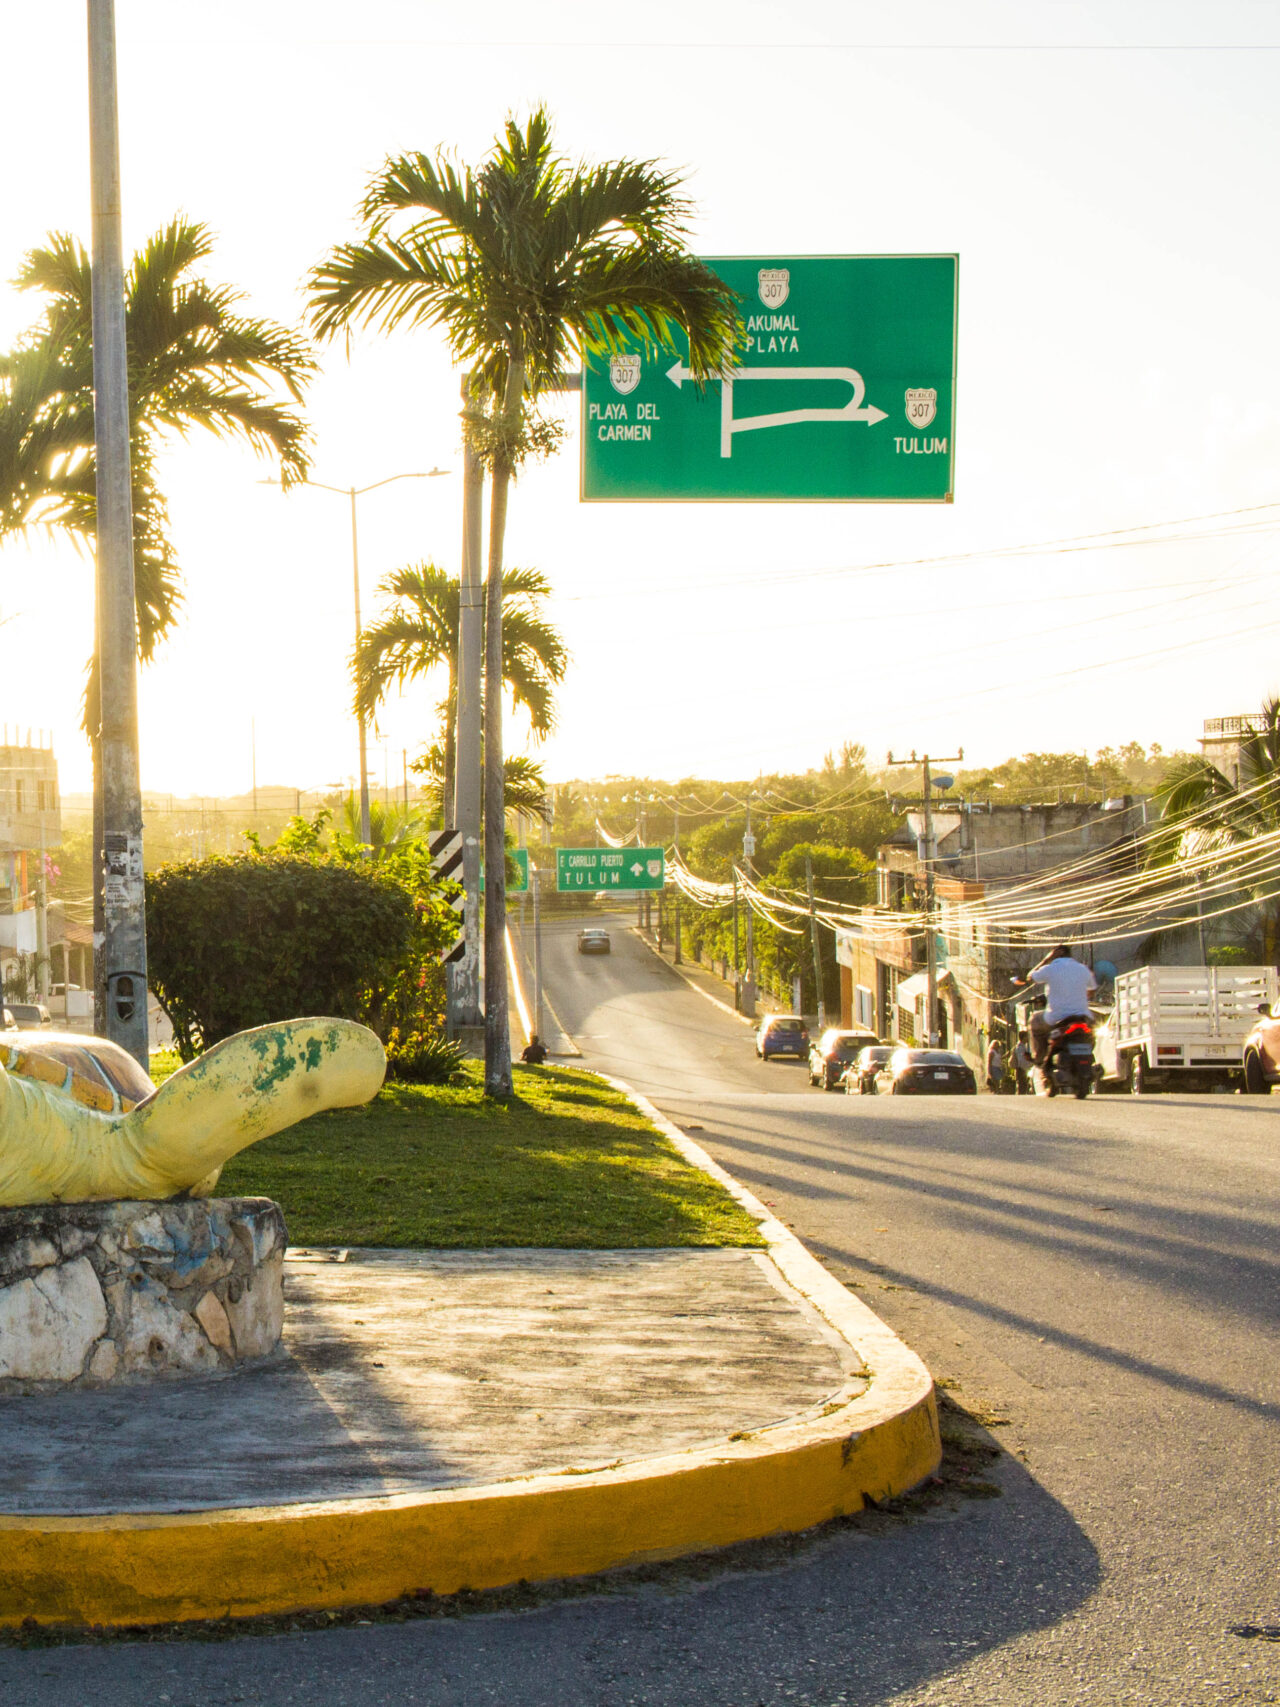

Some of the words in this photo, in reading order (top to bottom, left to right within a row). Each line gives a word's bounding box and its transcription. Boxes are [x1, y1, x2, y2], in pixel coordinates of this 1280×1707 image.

[765, 284, 782, 298] 307
[746, 315, 800, 332] AKUMAL
[745, 335, 799, 353] PLAYA
[616, 369, 634, 383] 307
[589, 403, 628, 420] PLAYA
[637, 403, 660, 420] DEL
[912, 403, 930, 418] 307
[598, 424, 652, 442] CARMEN
[893, 437, 947, 454] TULUM
[569, 855, 596, 867] CARRILLO
[601, 855, 624, 866] PUERTO
[565, 872, 619, 884] TULUM
